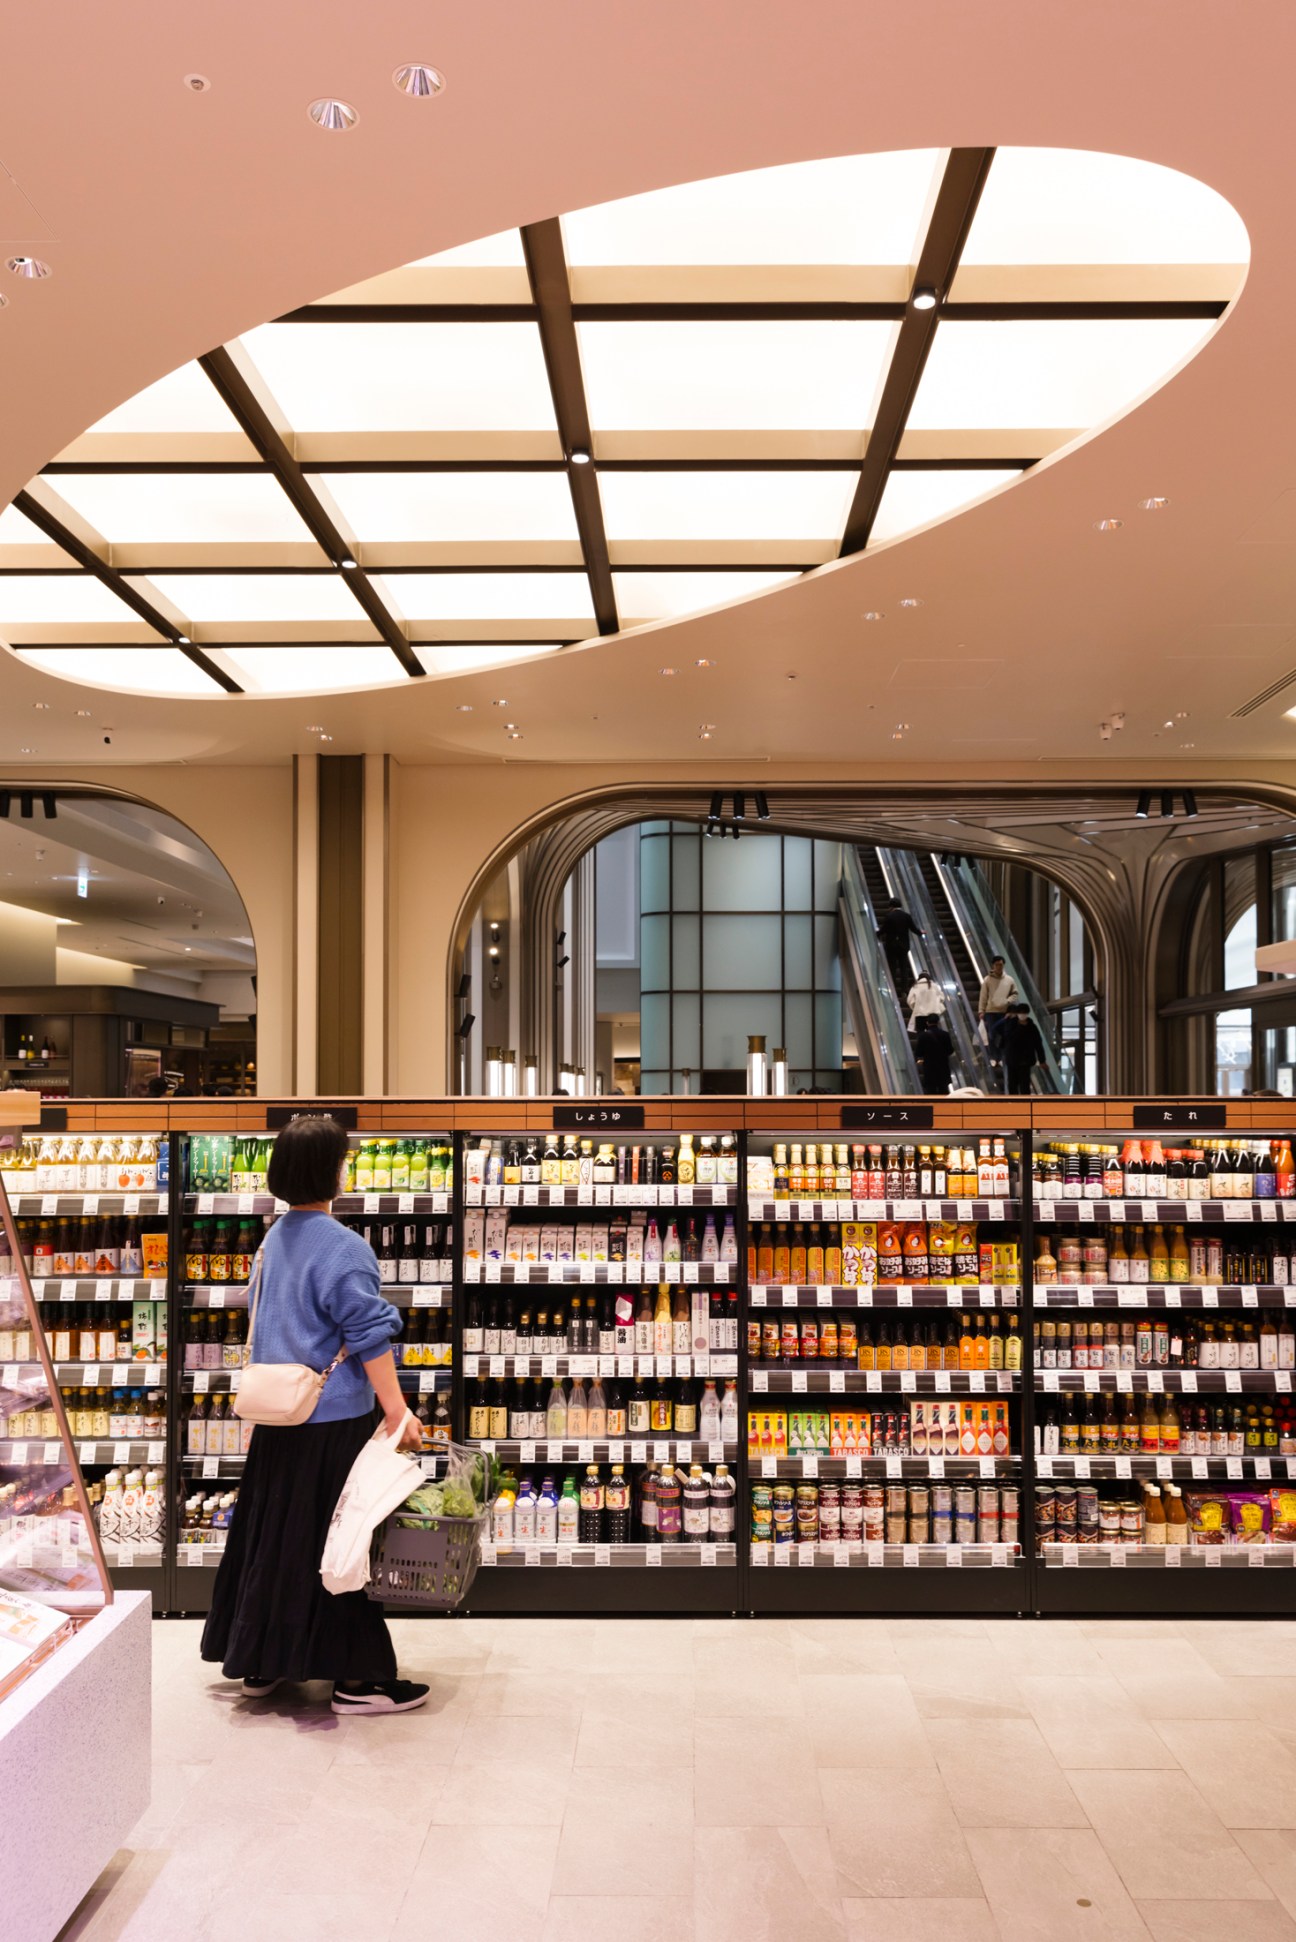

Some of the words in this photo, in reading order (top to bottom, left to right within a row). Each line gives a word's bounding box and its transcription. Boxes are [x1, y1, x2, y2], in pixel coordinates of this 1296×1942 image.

[575, 1112, 621, 1121] しょうゆ
[867, 1112, 909, 1121] ソース
[1163, 1111, 1198, 1121] たれ
[833, 1448, 869, 1456] TABASCO
[873, 1448, 909, 1456] TABASCO
